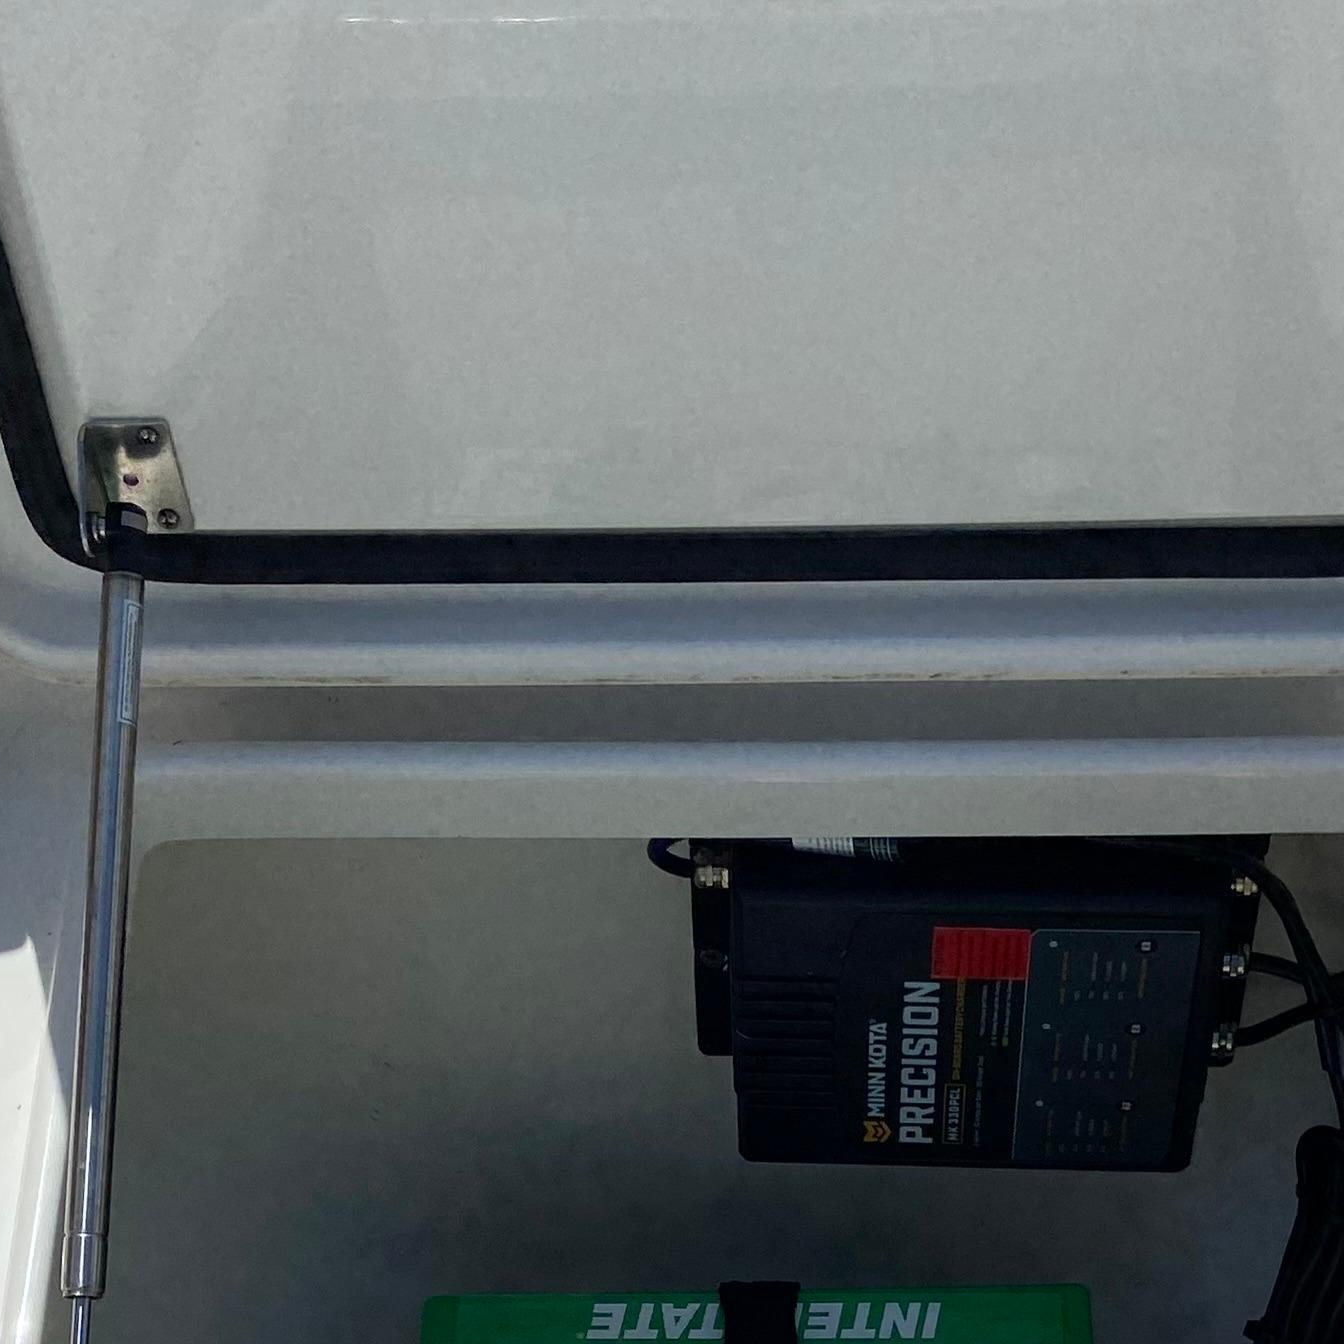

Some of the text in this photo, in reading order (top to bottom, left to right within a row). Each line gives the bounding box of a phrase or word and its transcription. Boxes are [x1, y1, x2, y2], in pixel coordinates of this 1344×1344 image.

[867, 1022, 887, 1117] MINN KOTA
[898, 981, 941, 1143] PRECISION
[586, 1301, 941, 1340] INTETATE
